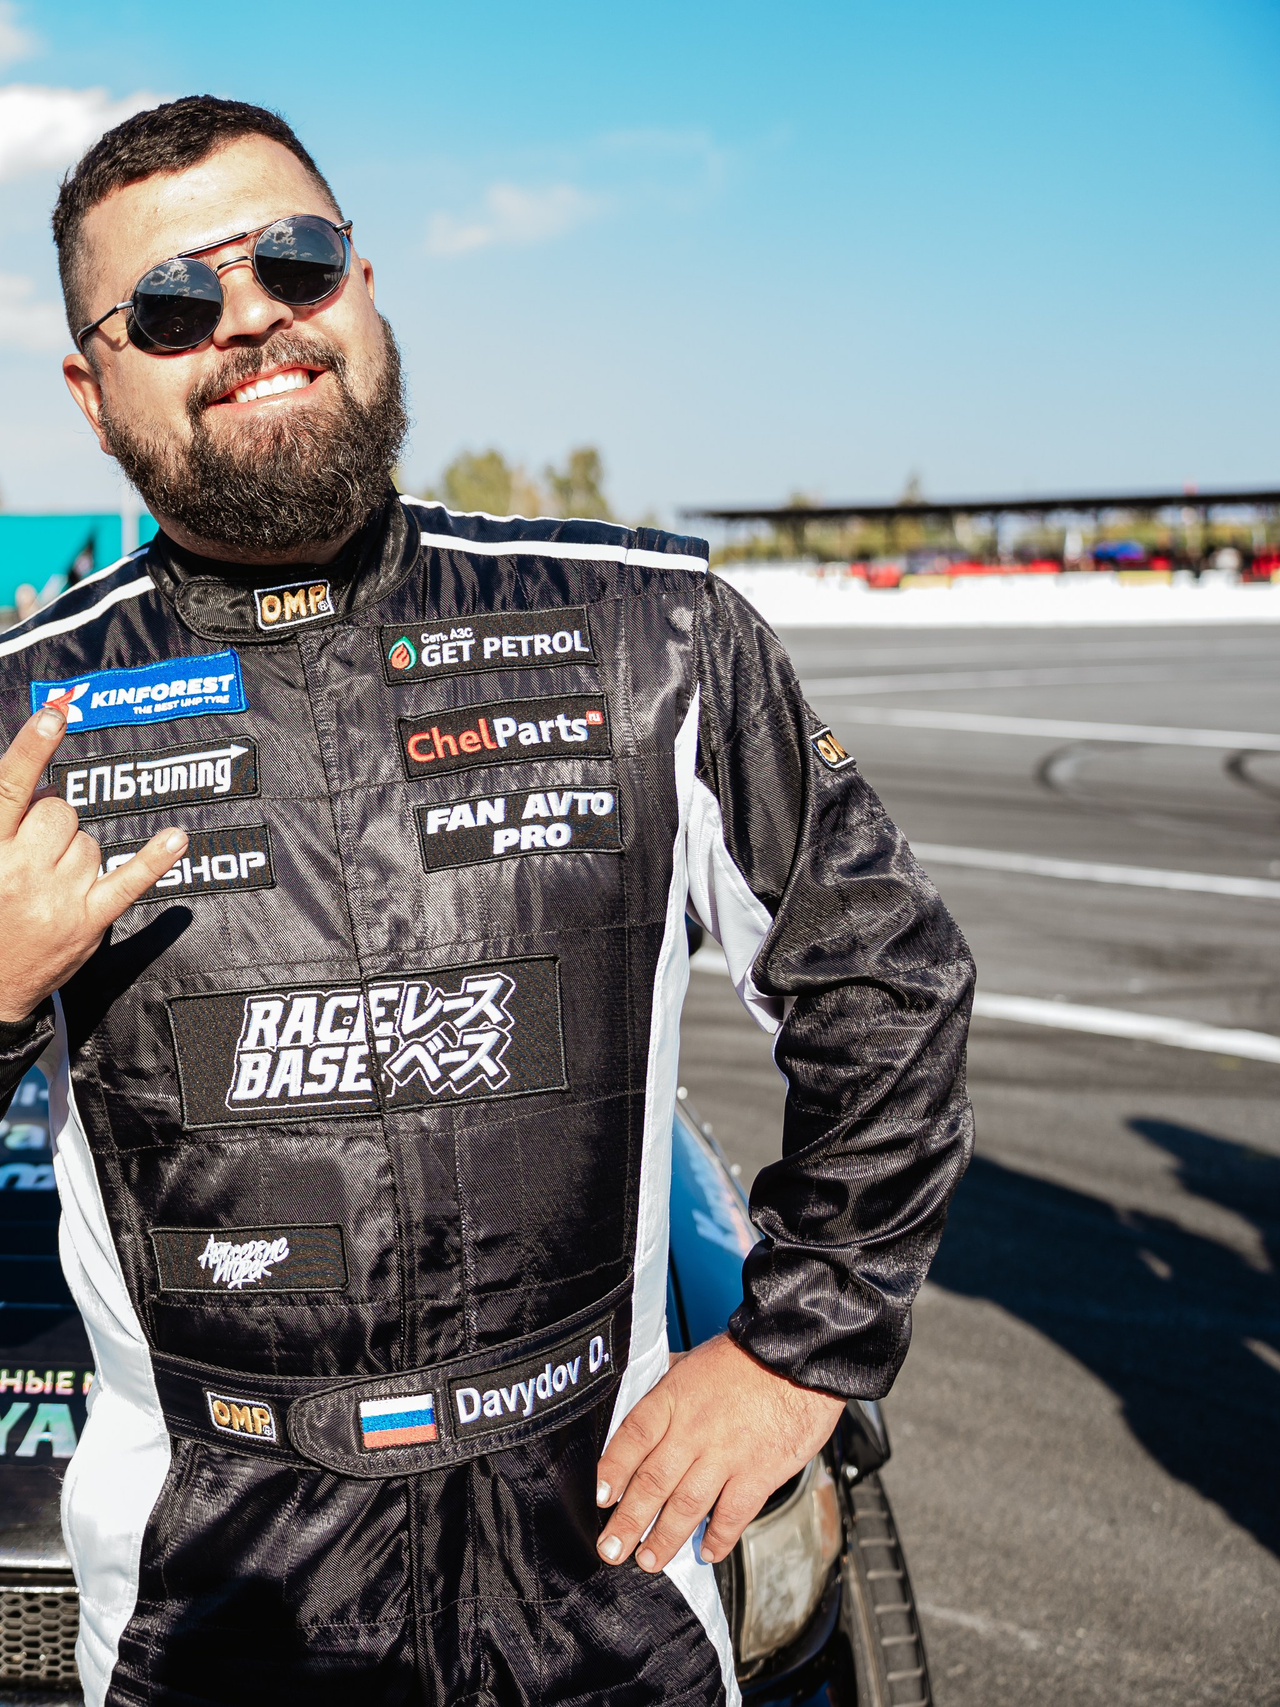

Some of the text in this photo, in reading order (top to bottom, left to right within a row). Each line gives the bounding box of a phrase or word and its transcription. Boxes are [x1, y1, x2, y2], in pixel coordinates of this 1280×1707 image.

[262, 585, 326, 624] OMP
[422, 630, 590, 667] GET PETROL
[450, 627, 473, 640] АЗС
[91, 674, 234, 708] KINFOREST
[133, 705, 152, 714] THE
[154, 700, 179, 712] BEST
[426, 792, 614, 834] FAN AVTO
[493, 822, 572, 854] PRO
[245, 986, 401, 1048] RACE
[231, 1040, 392, 1101] BASE
[456, 1334, 611, 1425] Davydov D.
[212, 1399, 271, 1435] OMP
